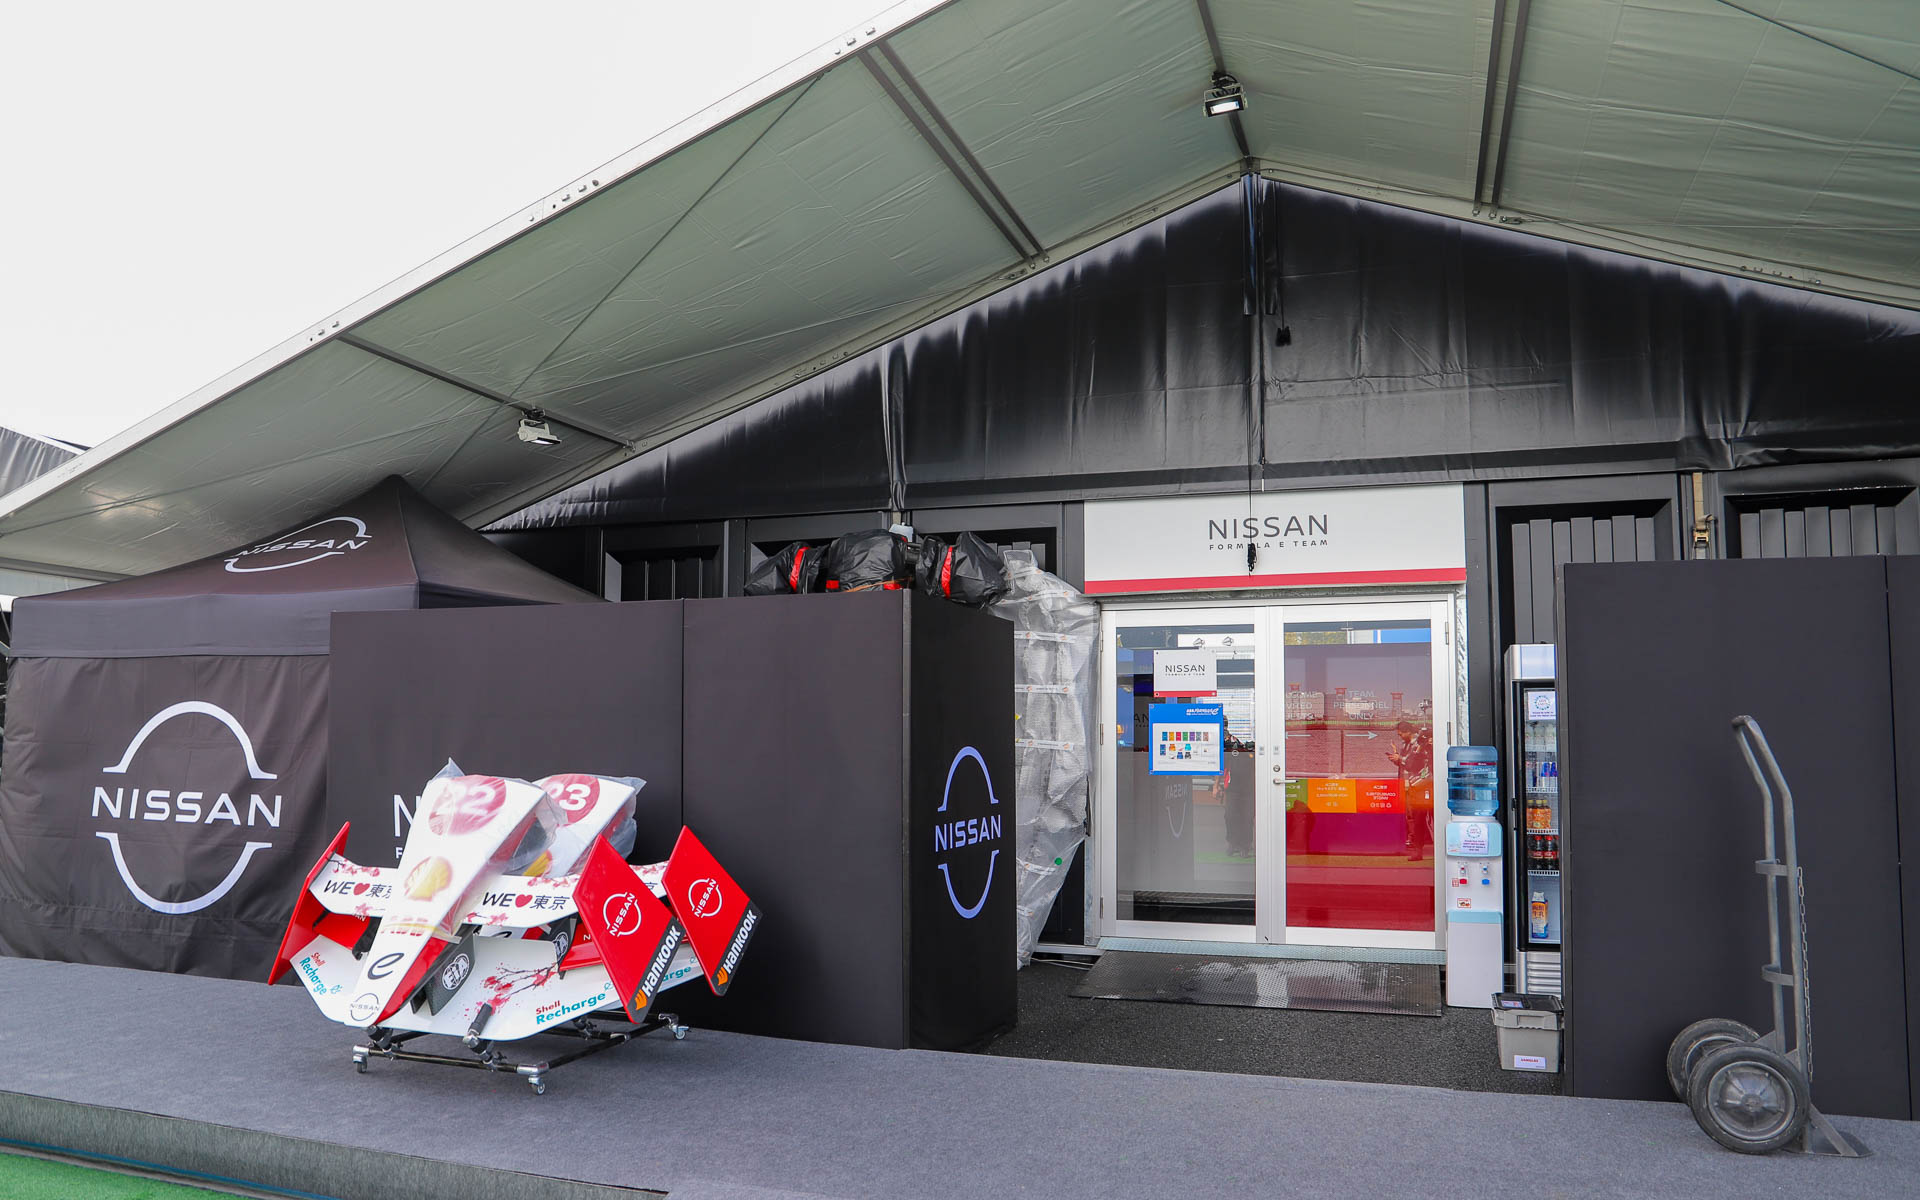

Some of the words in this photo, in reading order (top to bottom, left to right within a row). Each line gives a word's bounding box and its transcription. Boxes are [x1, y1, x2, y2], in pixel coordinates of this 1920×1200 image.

[1208, 514, 1328, 540] NISSAN
[229, 539, 369, 557] NISSAN
[1209, 541, 1271, 551] FORMLA
[1293, 539, 1328, 547] TEAM
[1165, 664, 1206, 673] NISSAN
[91, 786, 283, 828] NISSAN
[935, 815, 1001, 852] NISSAN
[324, 879, 355, 895] WE
[693, 878, 717, 918] NISSAN
[482, 891, 516, 908] WE
[529, 895, 570, 911] 東京
[609, 893, 636, 937] NISSAN
[300, 956, 327, 996] Recharge
[536, 1000, 561, 1015] Shell
[536, 992, 606, 1025] Recharge
